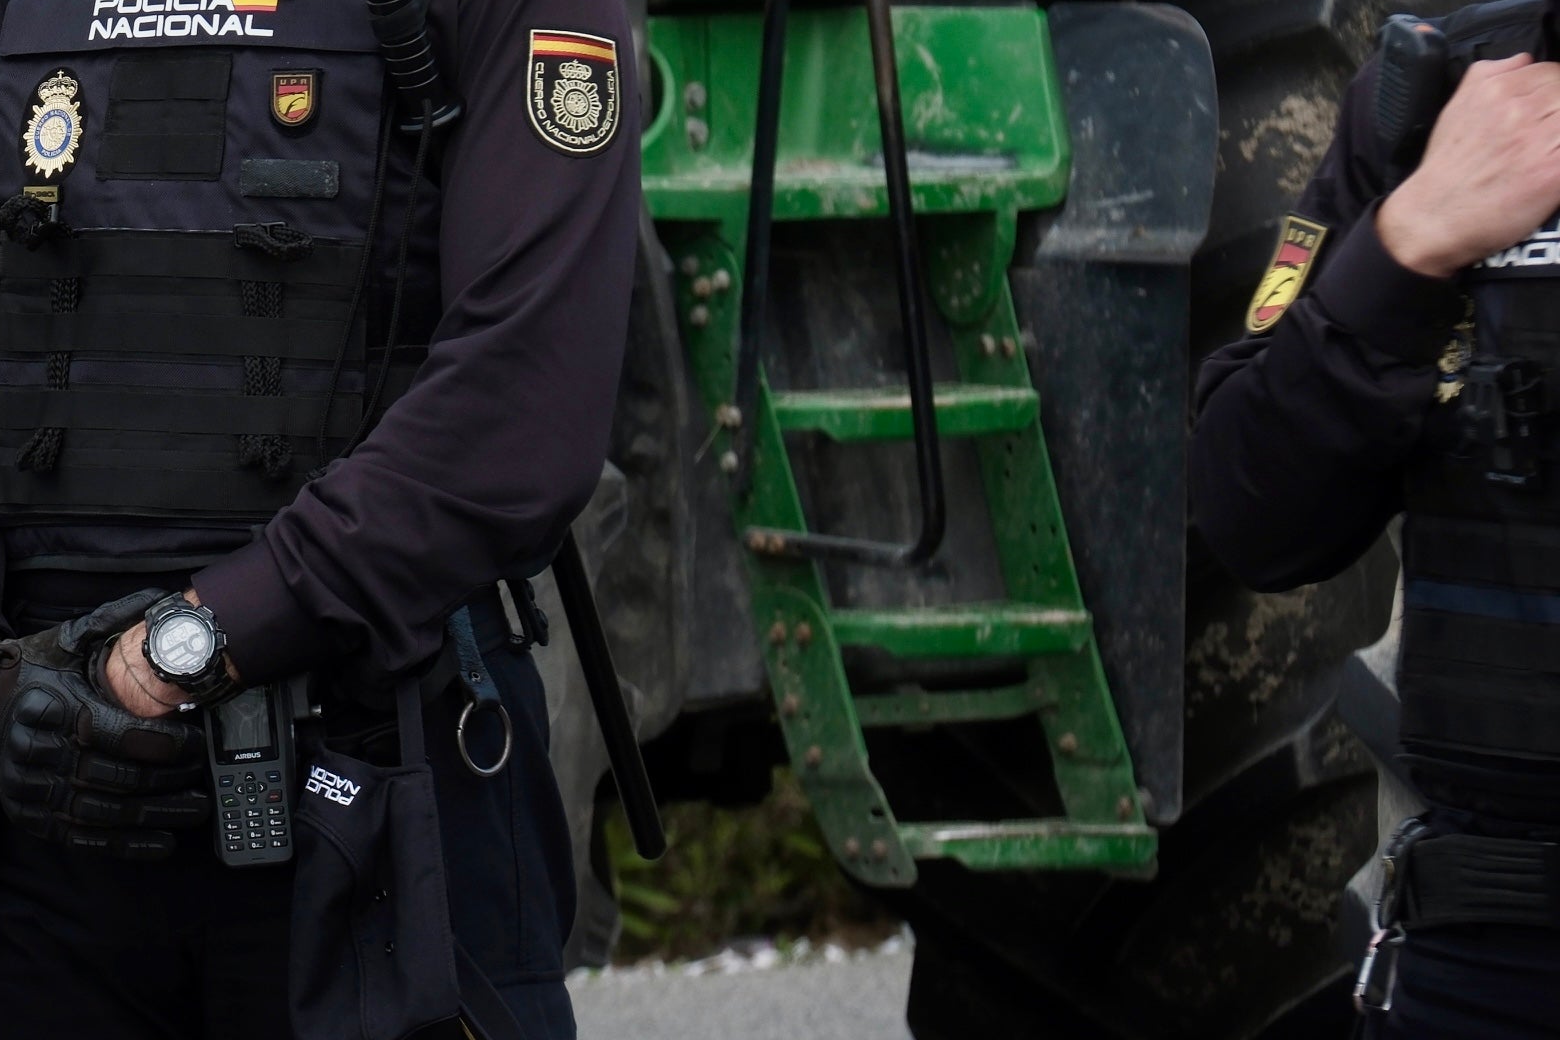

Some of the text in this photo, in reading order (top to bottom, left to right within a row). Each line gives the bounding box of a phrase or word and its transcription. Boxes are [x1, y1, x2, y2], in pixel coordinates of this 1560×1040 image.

[88, 14, 274, 41] NACIONAL
[534, 61, 548, 120] CUERPO
[542, 120, 599, 145] NACIONAL
[607, 70, 615, 122] POLICIA
[235, 751, 262, 760] AIRBUS
